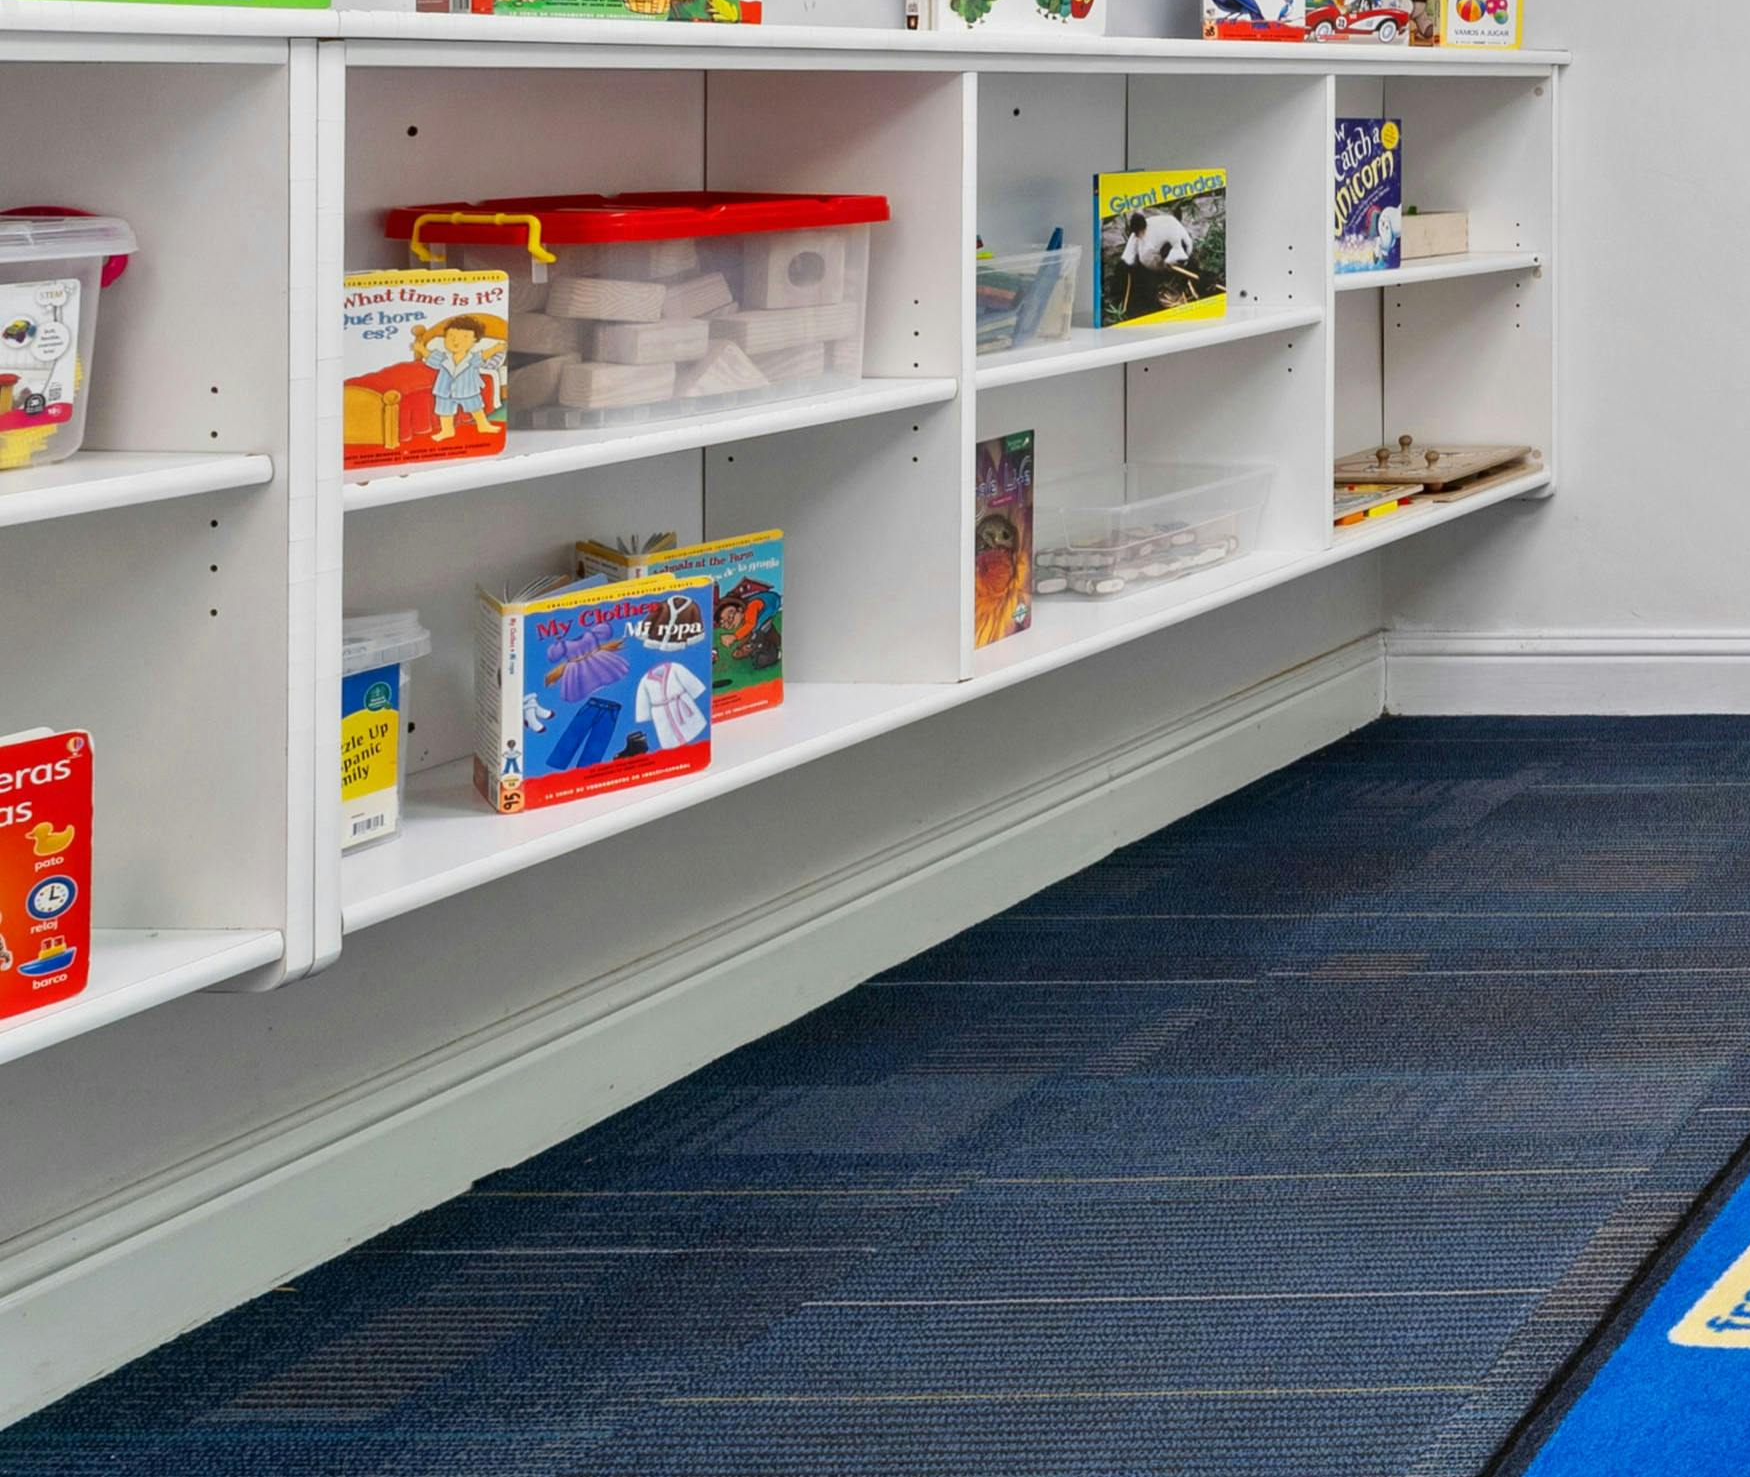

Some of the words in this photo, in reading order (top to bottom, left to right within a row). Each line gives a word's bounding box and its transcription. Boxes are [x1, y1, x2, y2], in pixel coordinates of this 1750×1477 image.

[1453, 28, 1477, 37] VAMOS
[1485, 30, 1510, 38] JUGAR
[1372, 127, 1381, 144] a
[1109, 188, 1157, 214] Giant
[1161, 173, 1224, 199] Pandas
[40, 290, 64, 299] STEM
[344, 287, 394, 310] What
[399, 288, 446, 306] time
[450, 293, 469, 307] is
[475, 287, 504, 306] it?
[377, 309, 427, 324] hora
[362, 325, 399, 340] es?
[694, 558, 706, 568] at
[709, 554, 726, 566] the
[728, 551, 754, 563] Farm
[536, 618, 573, 642] My
[578, 601, 660, 626] Clothes
[622, 620, 651, 639] Mi
[657, 622, 703, 641] ropa
[368, 722, 389, 740] Up
[34, 855, 65, 872] pato
[29, 920, 59, 935] reloj
[32, 972, 68, 990] barco
